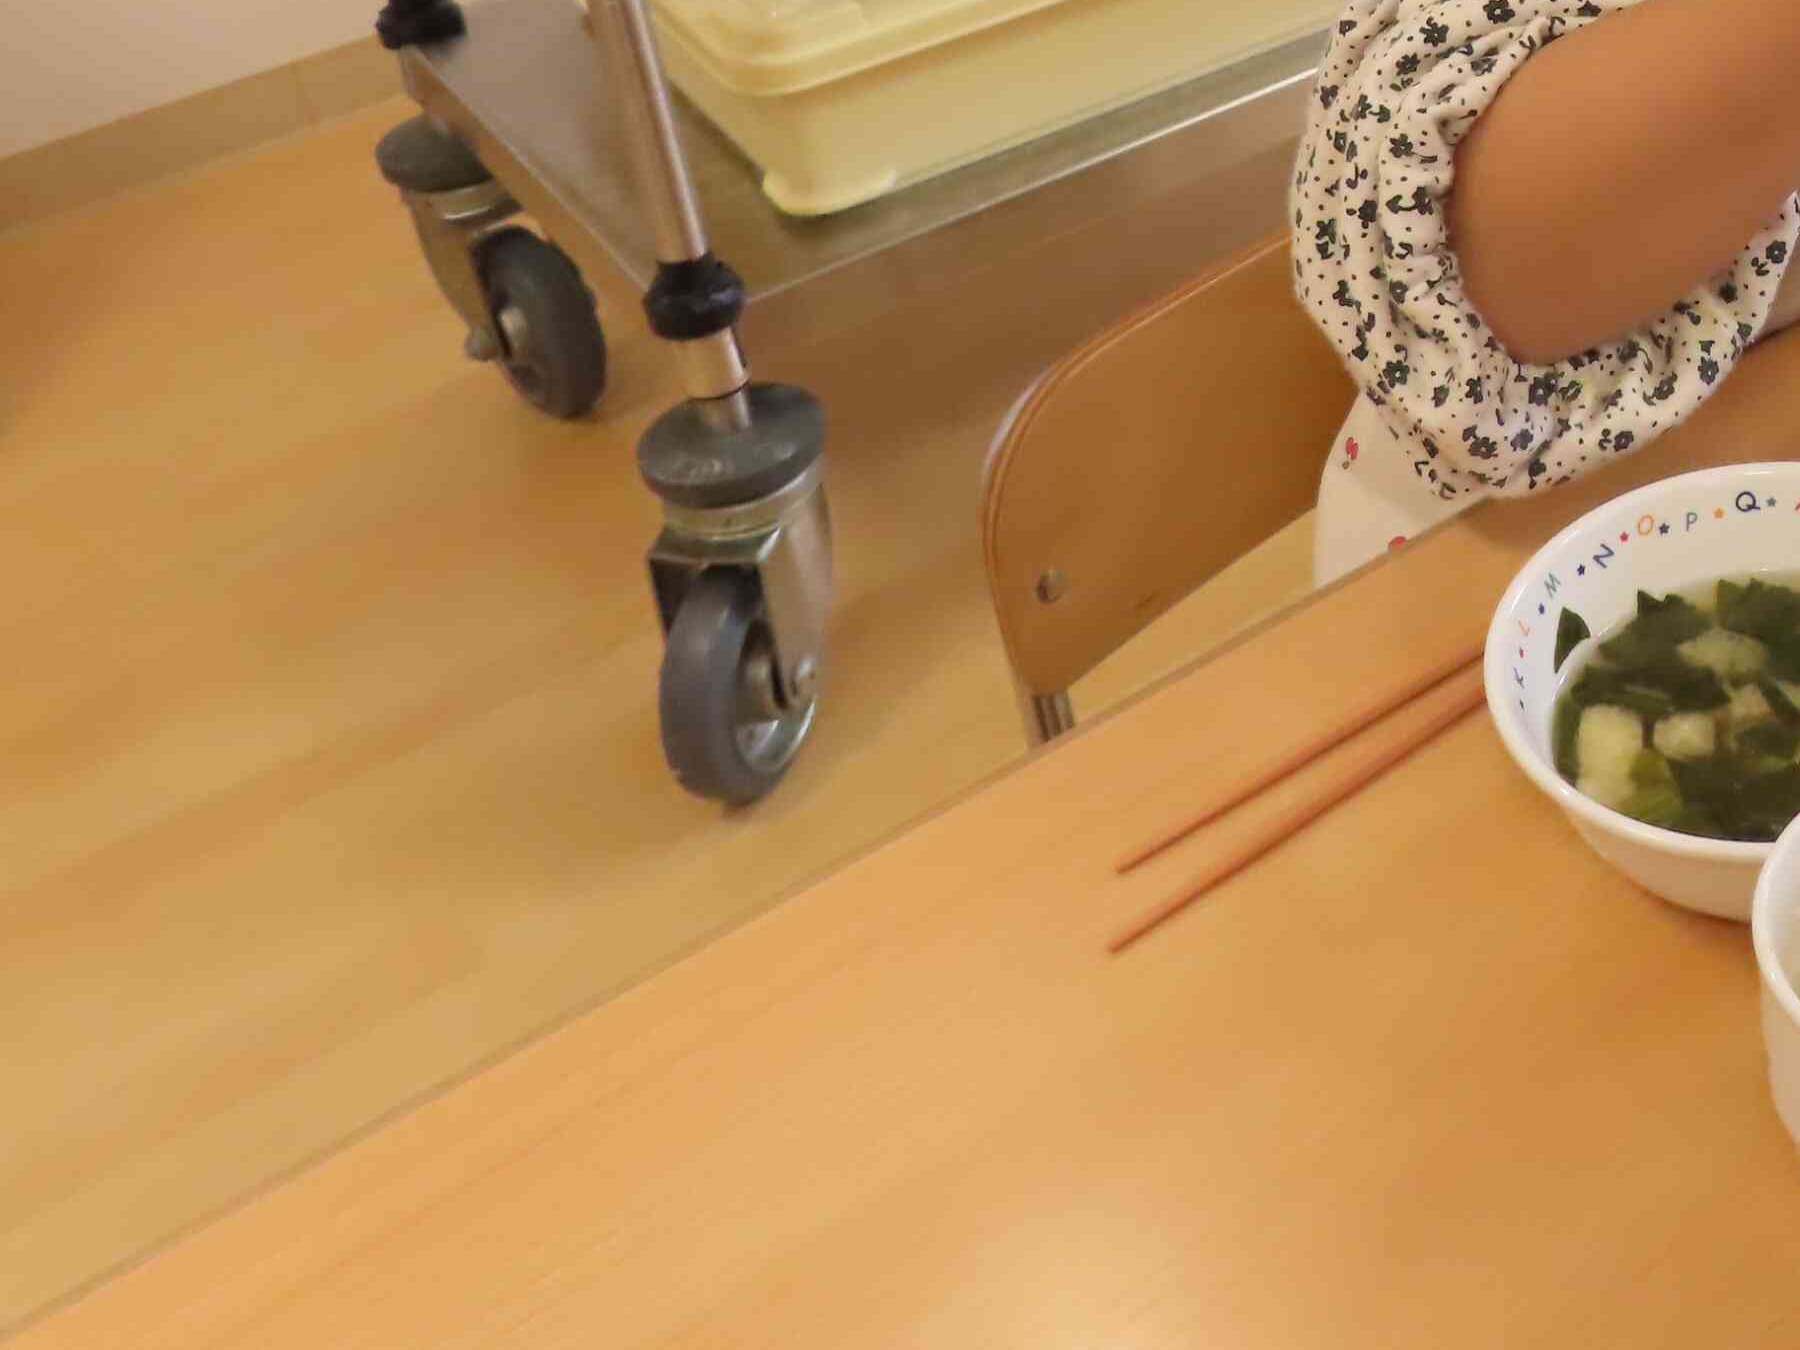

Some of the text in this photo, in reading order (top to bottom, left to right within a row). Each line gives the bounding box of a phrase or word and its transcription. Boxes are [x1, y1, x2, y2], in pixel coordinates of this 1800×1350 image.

[1592, 543, 1615, 569] N
[1637, 514, 1655, 536] O
[1685, 511, 1698, 532] P
[1735, 491, 1761, 513] Q
